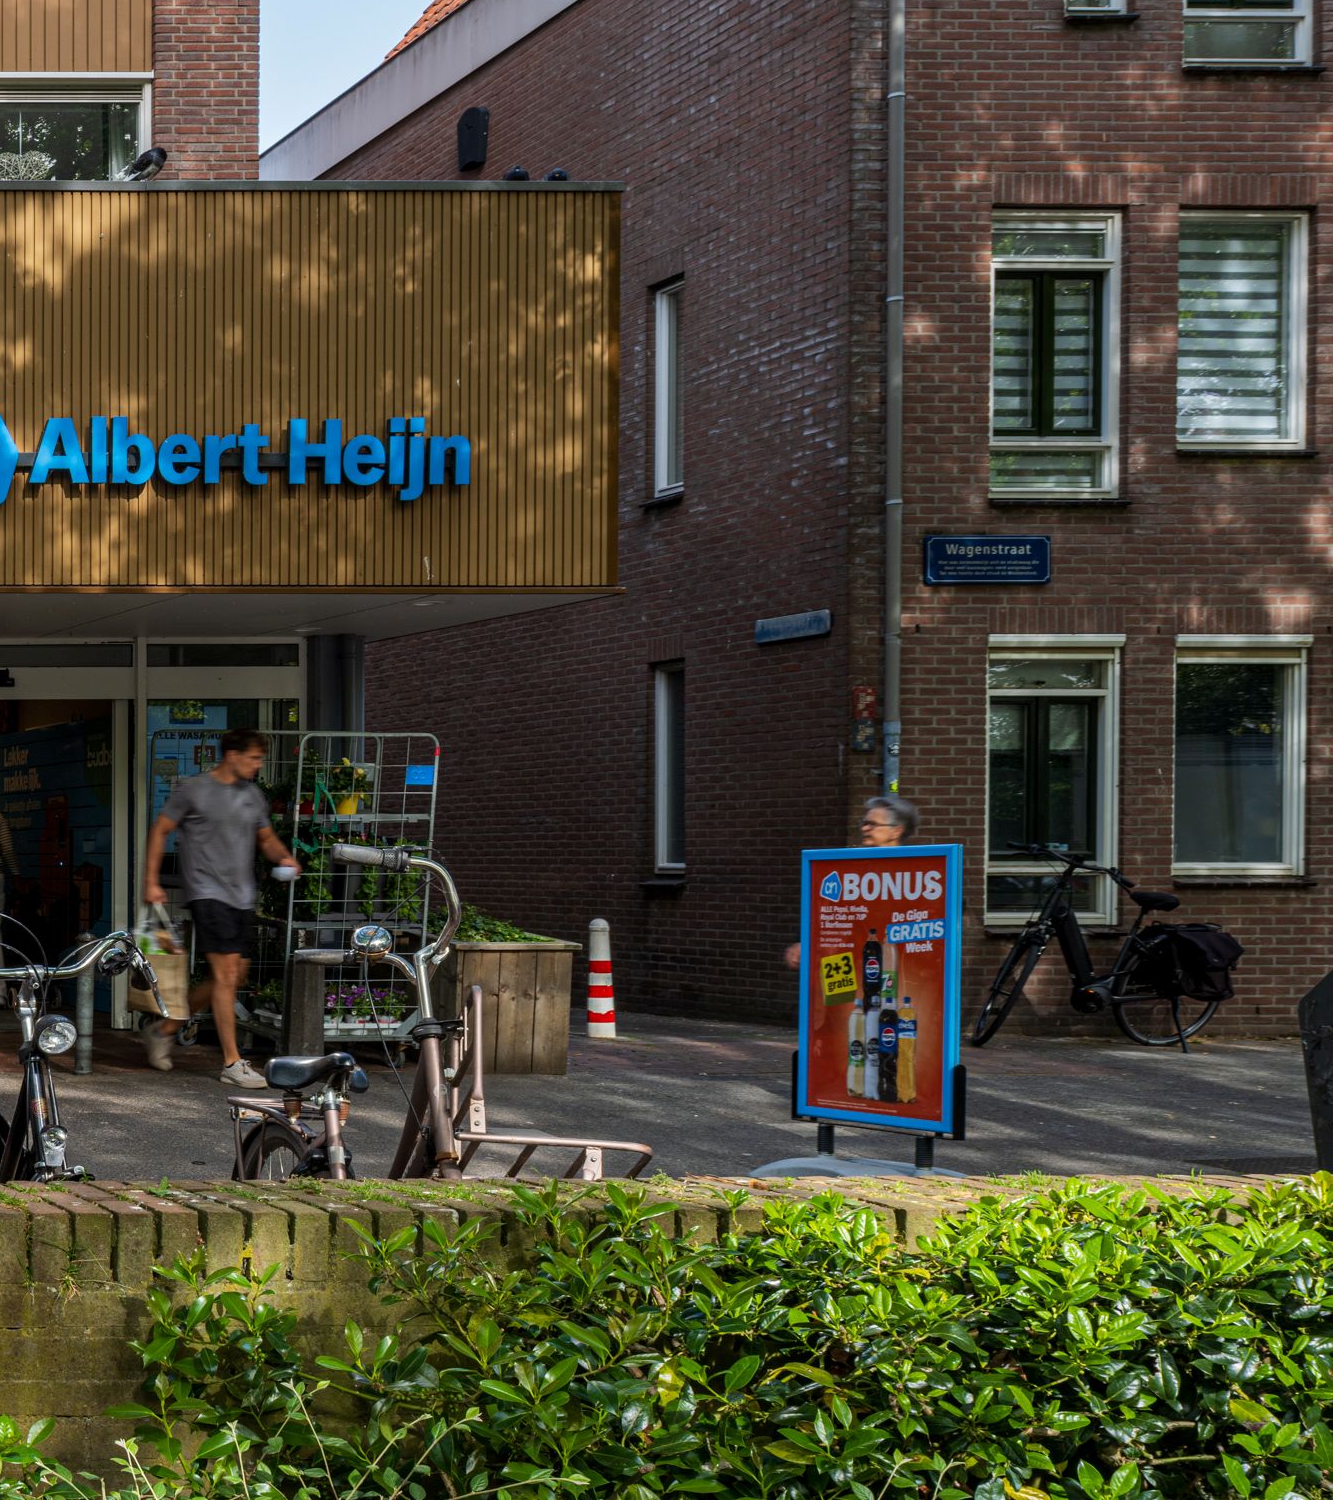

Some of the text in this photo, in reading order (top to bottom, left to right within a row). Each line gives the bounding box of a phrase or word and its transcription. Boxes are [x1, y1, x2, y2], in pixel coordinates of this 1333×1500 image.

[29, 415, 270, 486] Albert
[288, 416, 470, 501] Heijn
[946, 544, 1032, 557] Wagenstraat
[842, 870, 943, 901] BONUS
[892, 909, 929, 922] De Giga
[890, 920, 944, 942] GRATIS
[905, 941, 934, 953] Week
[824, 955, 853, 978] 2+3
[827, 976, 854, 993] gratis
